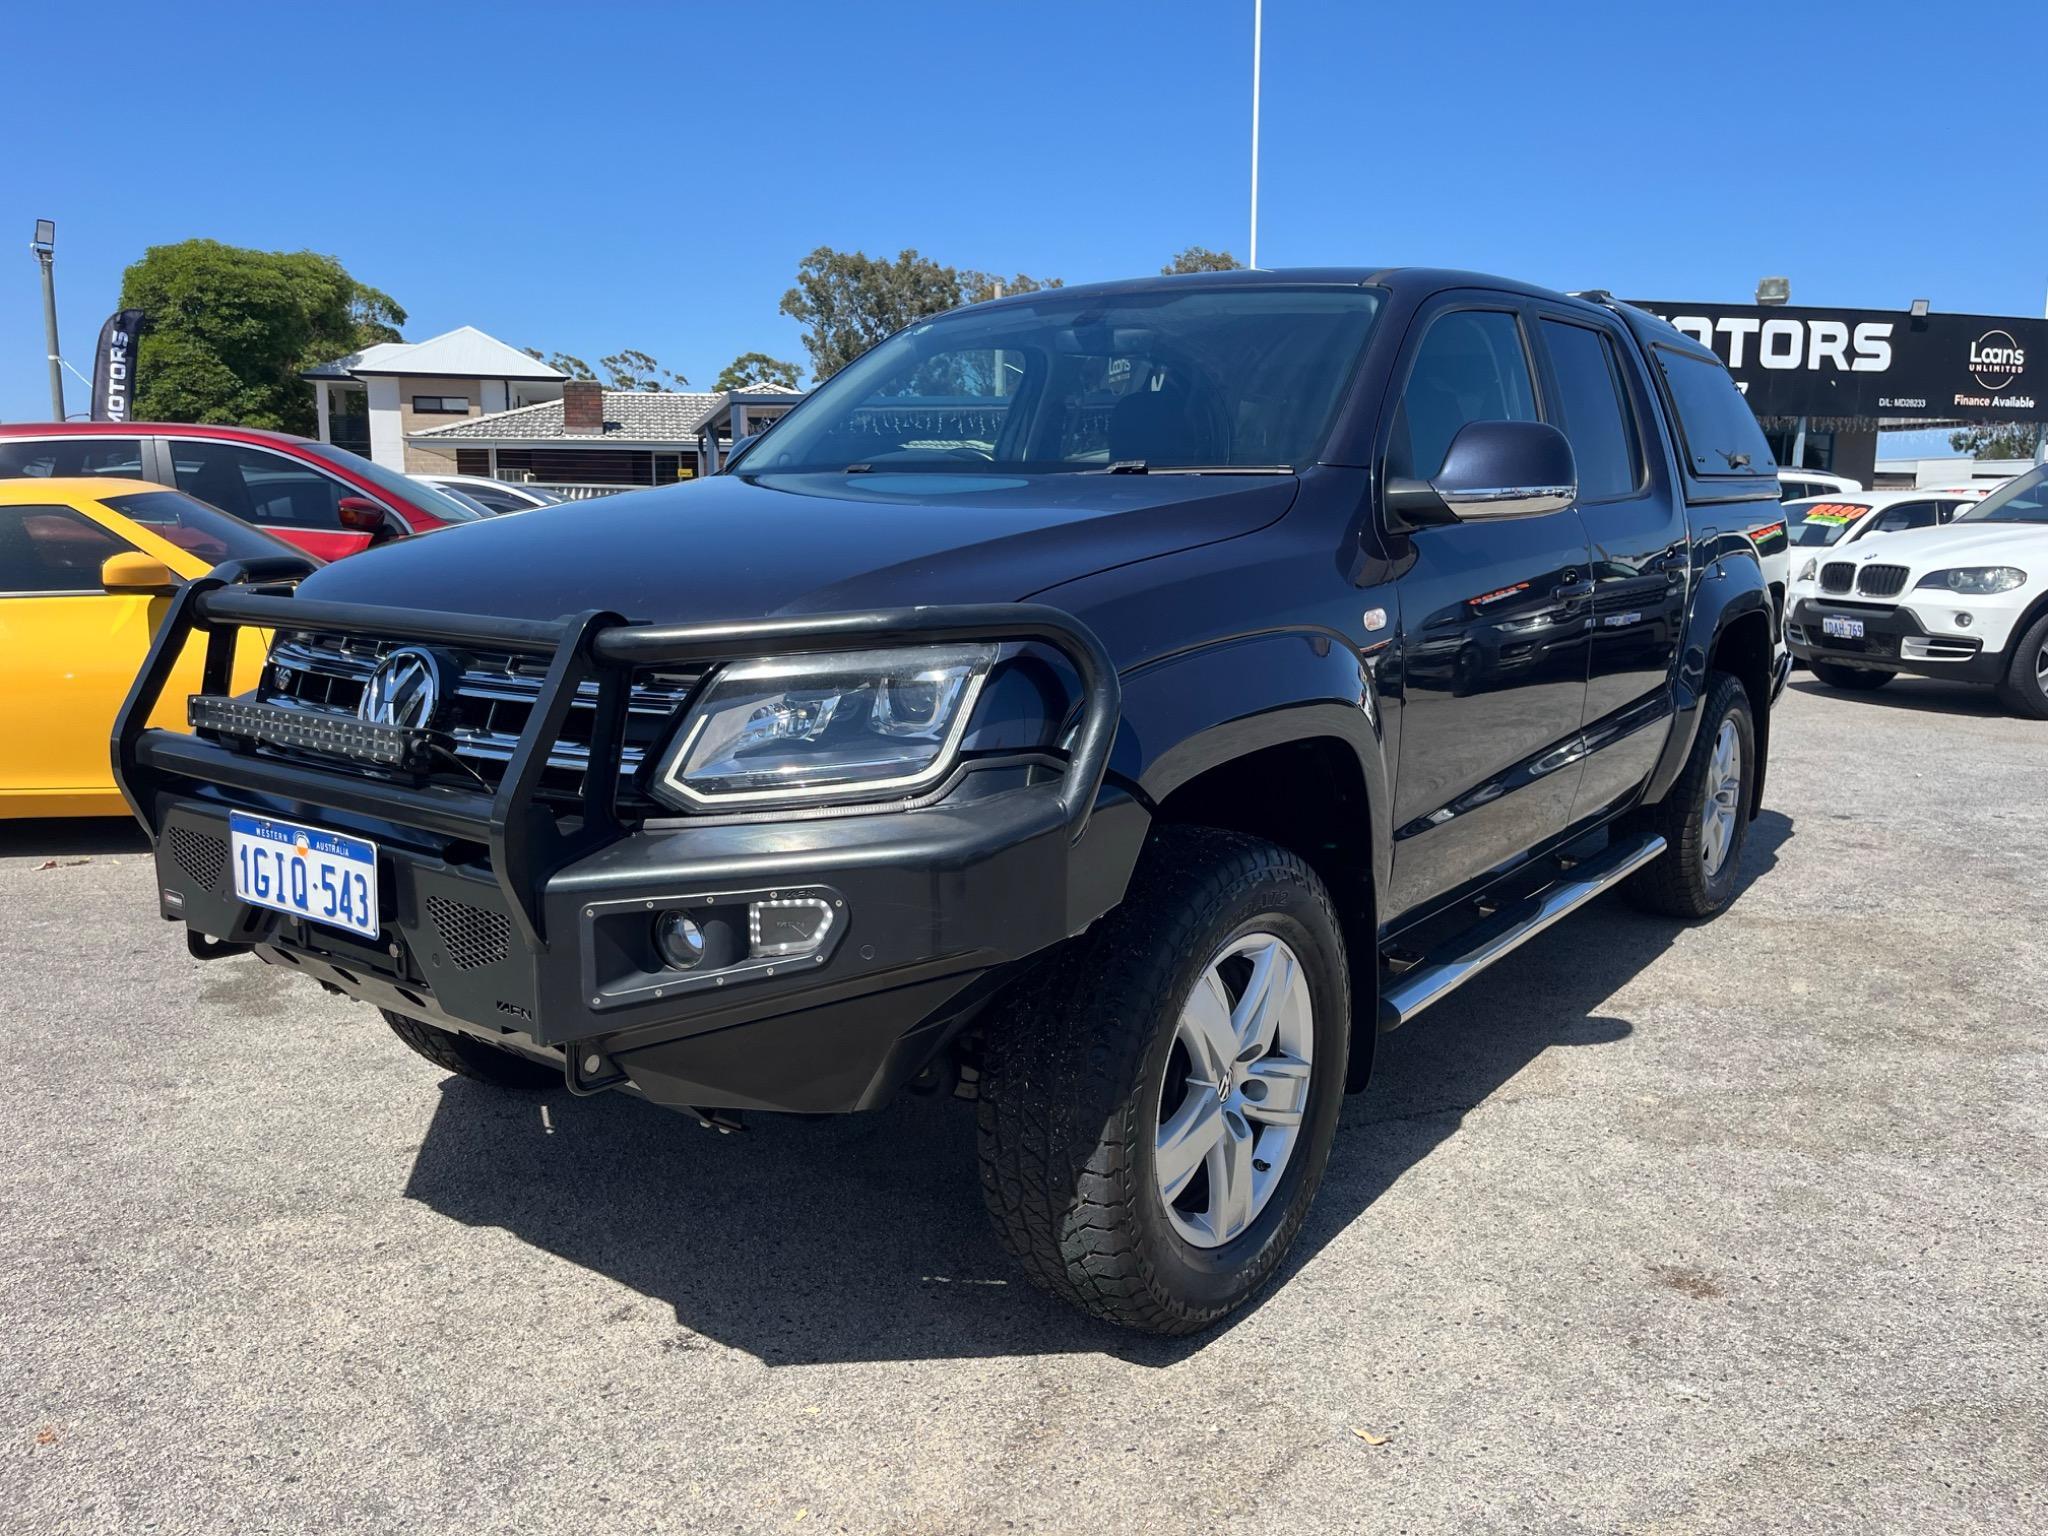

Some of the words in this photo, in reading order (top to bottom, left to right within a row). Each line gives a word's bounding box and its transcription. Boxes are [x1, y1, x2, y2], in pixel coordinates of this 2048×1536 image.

[1656, 314, 1894, 372] TORS
[1970, 341, 2025, 365] Loans
[1968, 364, 2024, 374] UNLIMITED
[1954, 394, 1990, 407] Finance
[1991, 395, 2035, 409] Available
[255, 827, 288, 842] WESTERN
[315, 841, 349, 857] AUSTRALIA
